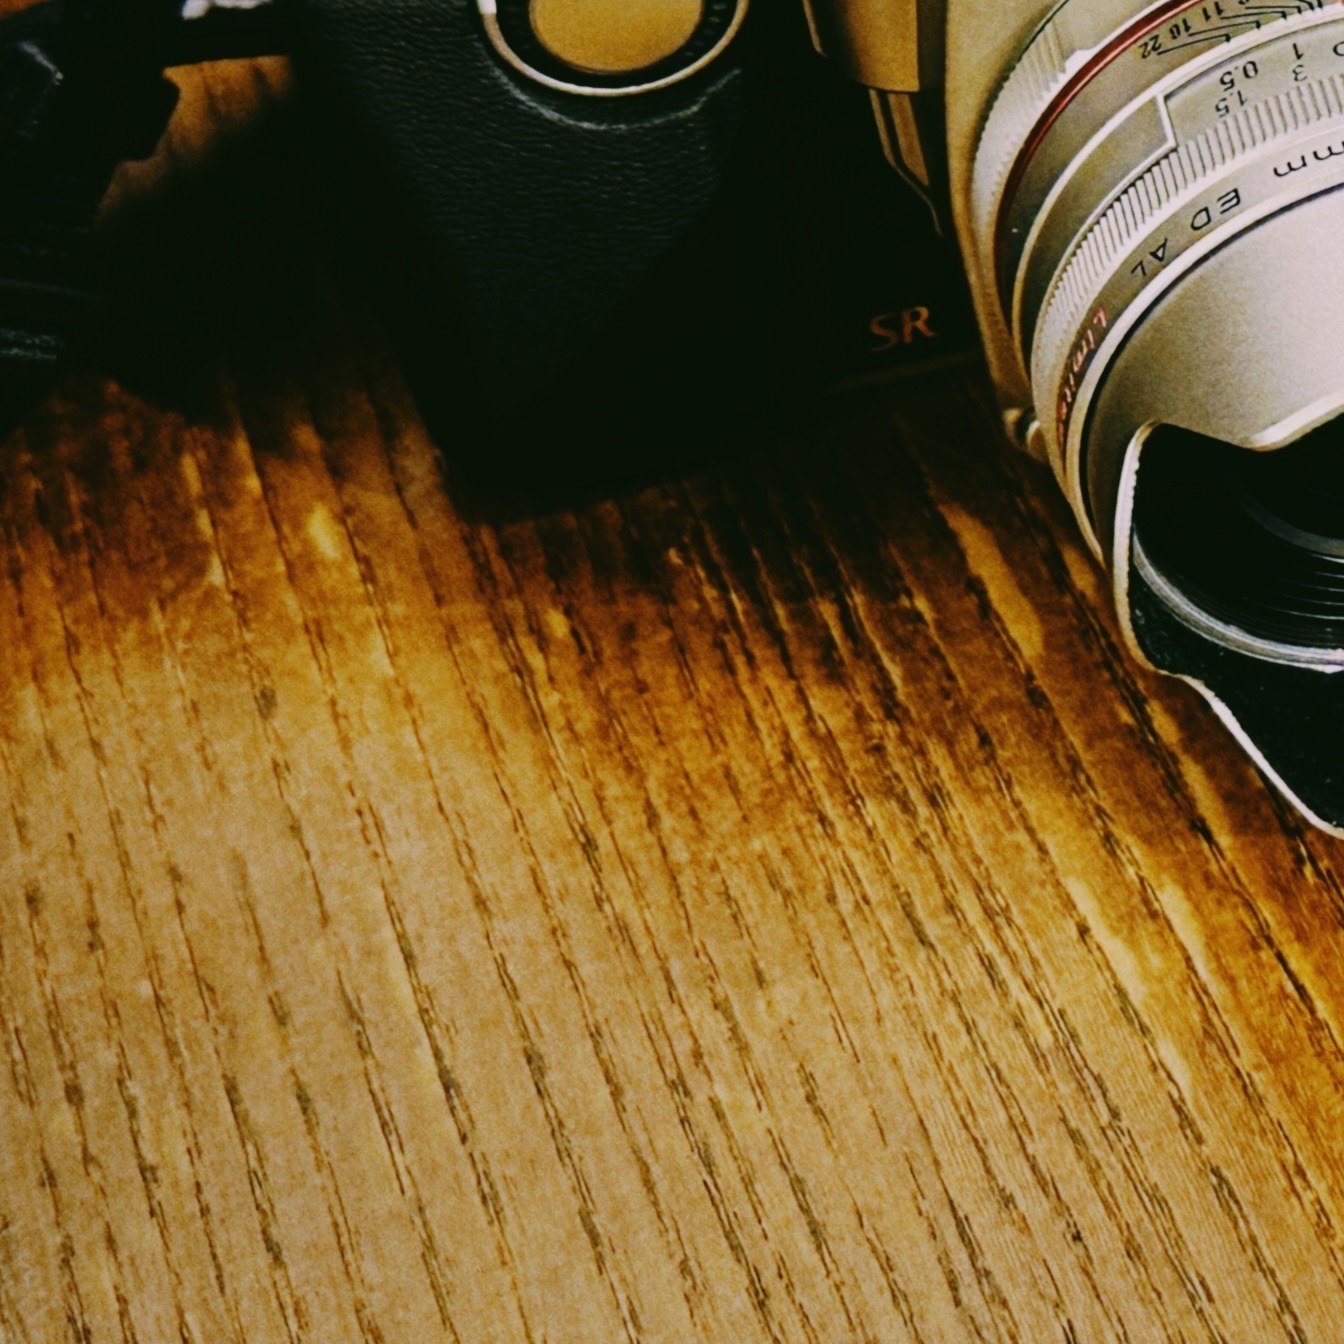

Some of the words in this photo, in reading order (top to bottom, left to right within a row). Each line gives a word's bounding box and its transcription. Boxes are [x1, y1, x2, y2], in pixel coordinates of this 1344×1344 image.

[1190, 188, 1241, 231] ED
[1130, 238, 1168, 277] AL
[869, 306, 940, 353] SR
